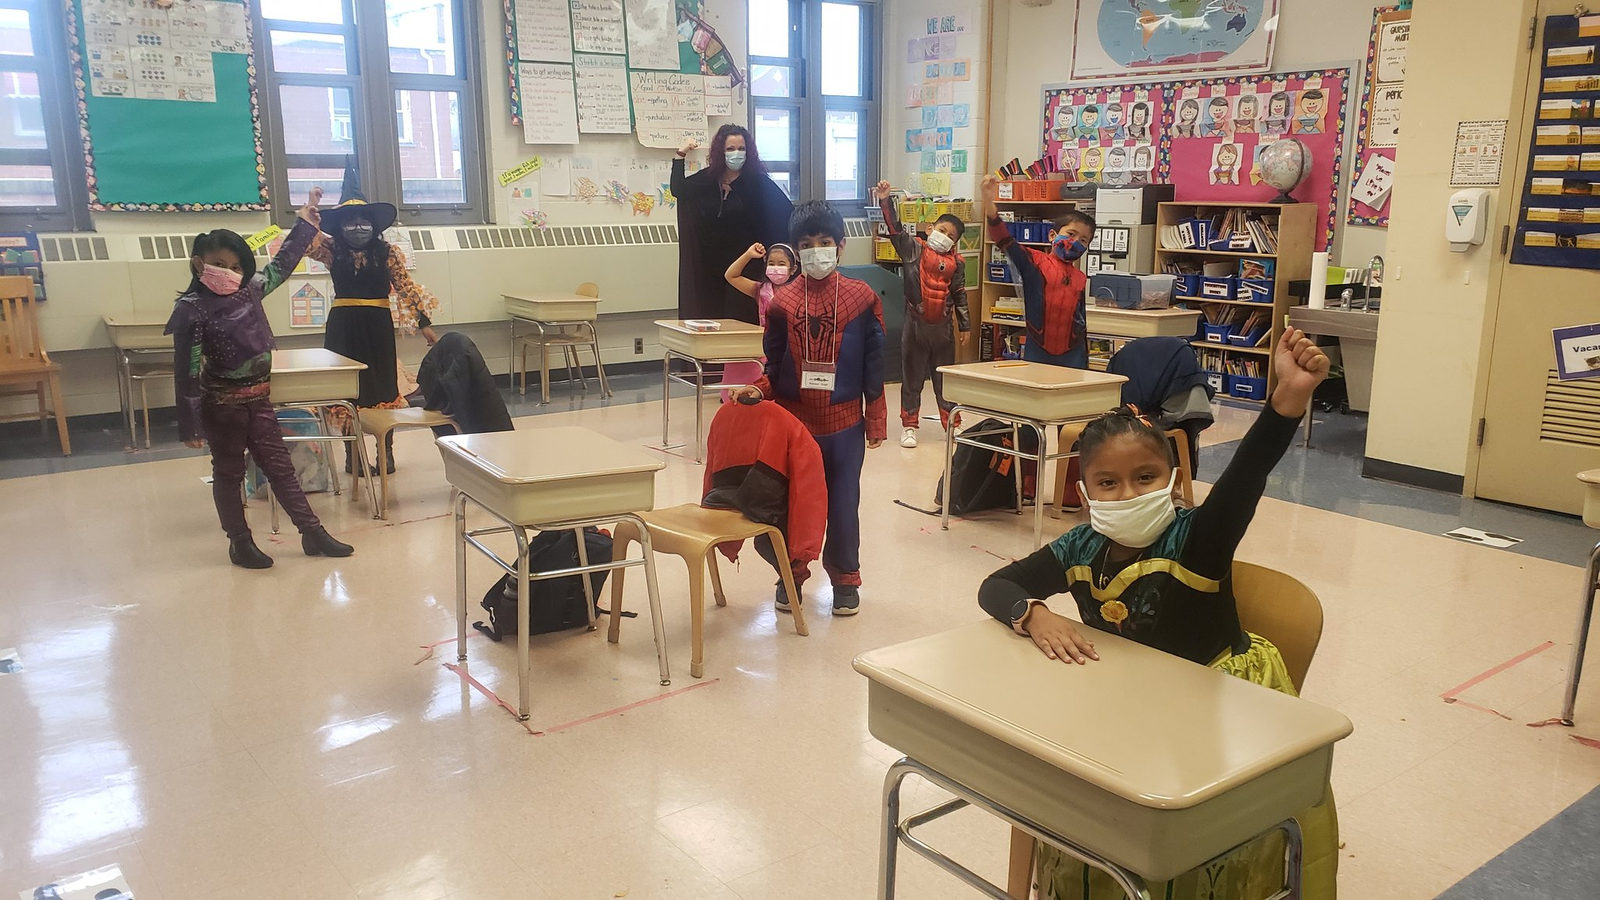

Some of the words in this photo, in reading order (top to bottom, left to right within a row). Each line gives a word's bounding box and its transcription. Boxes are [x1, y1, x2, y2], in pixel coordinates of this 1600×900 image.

[927, 17, 938, 35] WE
[940, 16, 956, 33] ARE
[638, 72, 668, 85] Writing
[669, 74, 690, 86] Codes
[922, 152, 963, 171] SISTENT
